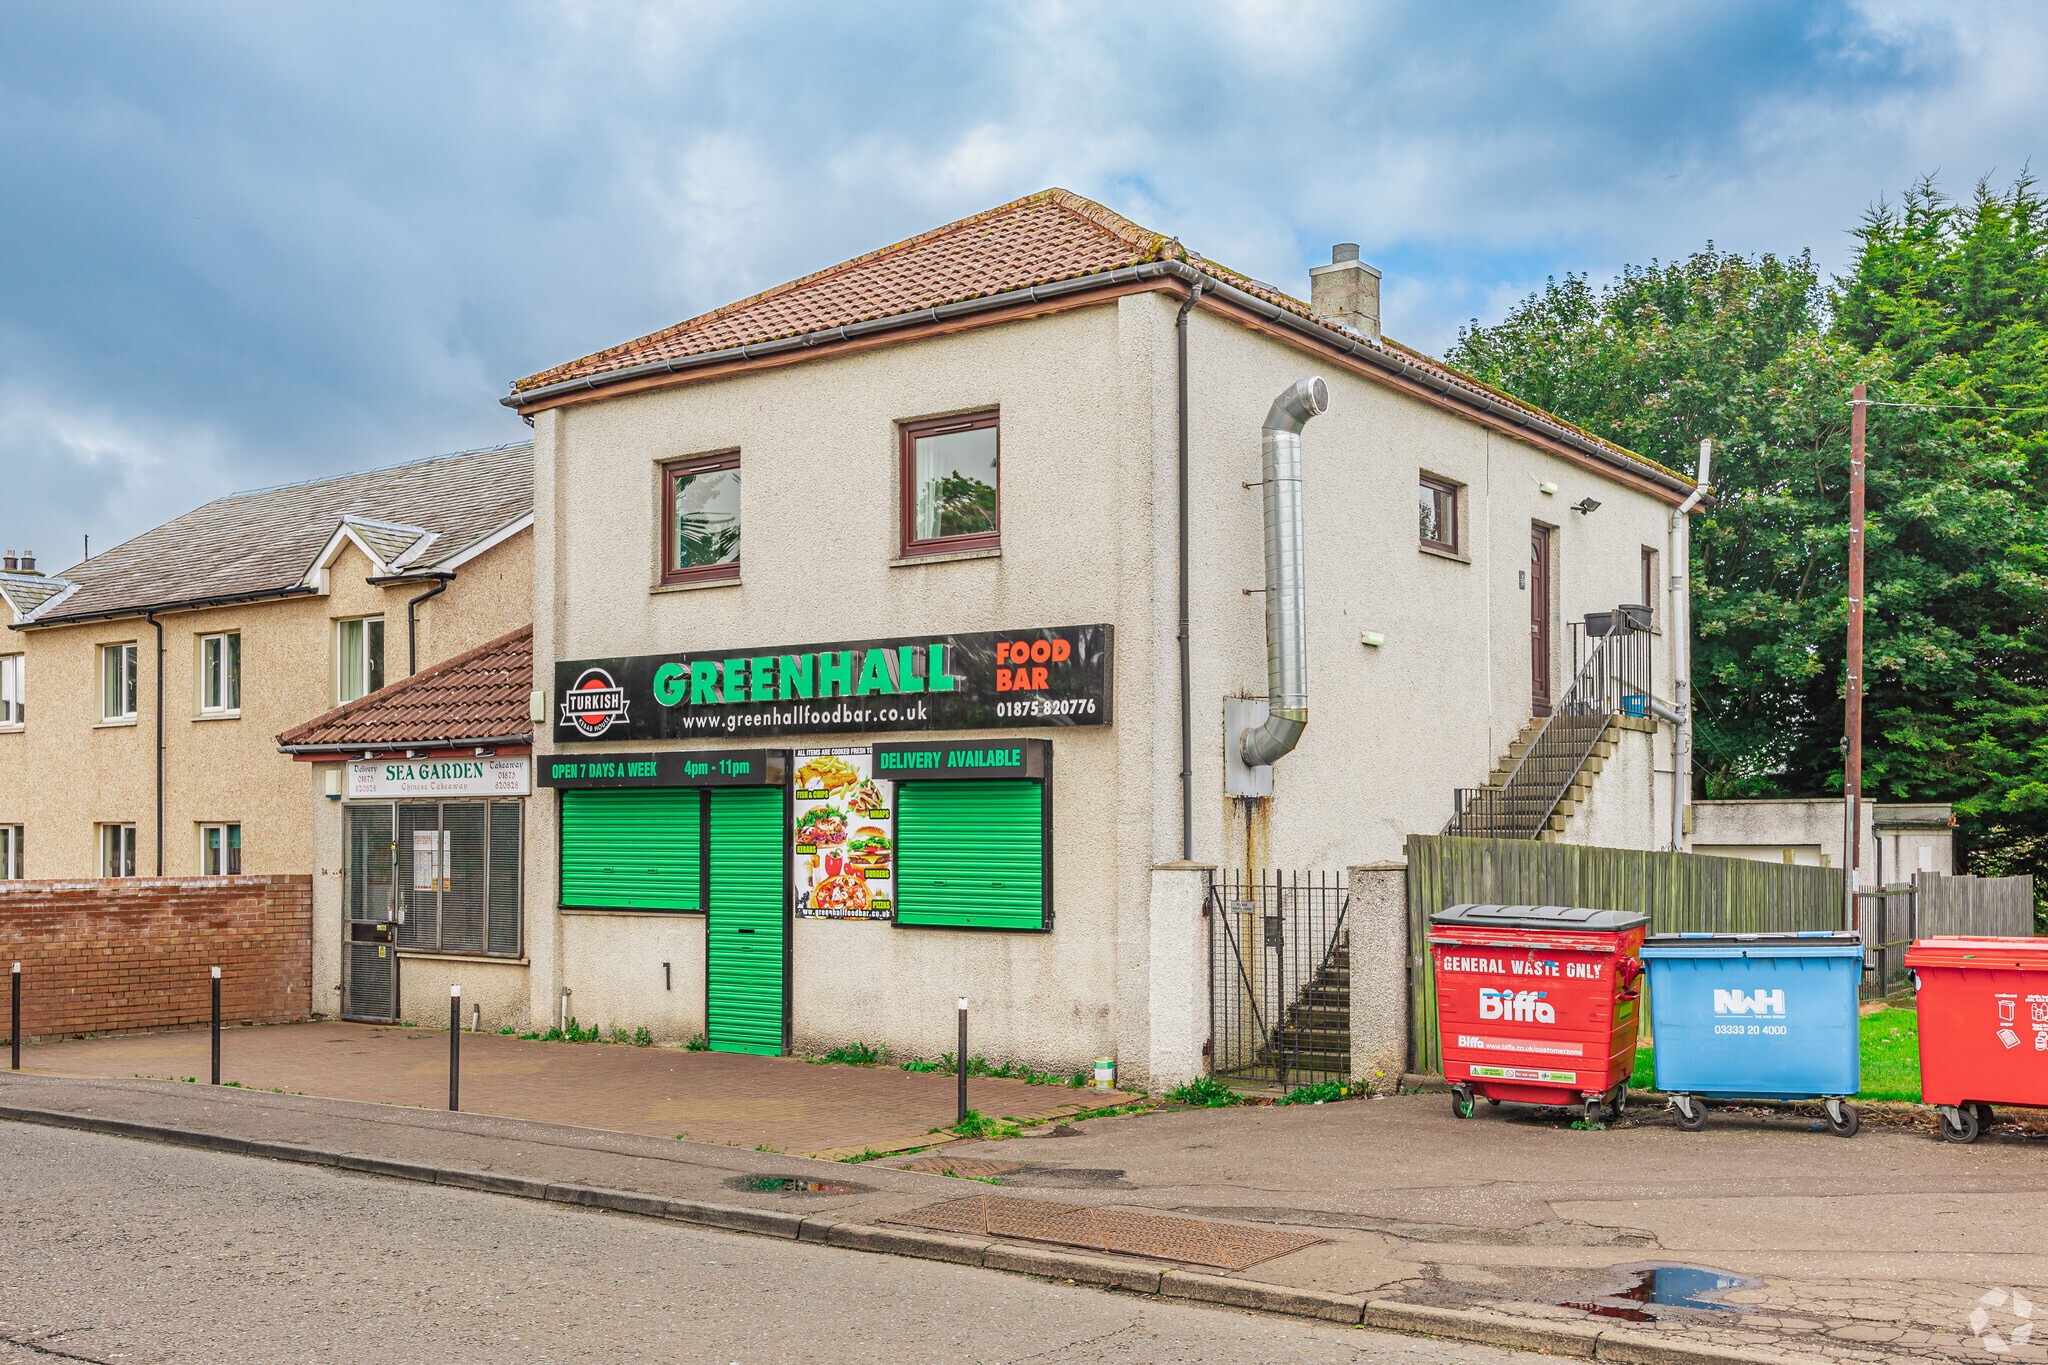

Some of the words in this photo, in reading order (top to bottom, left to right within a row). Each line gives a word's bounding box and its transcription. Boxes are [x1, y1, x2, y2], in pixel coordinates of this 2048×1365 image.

[996, 638, 1071, 665] FOOD
[653, 644, 955, 707] GREENHALL
[996, 667, 1049, 692] BAR
[570, 694, 619, 710] TURKISH
[996, 701, 1039, 717] 01875
[1043, 698, 1096, 716] 820776
[578, 717, 593, 732] KEBAB
[594, 716, 611, 732] HOUSE
[683, 700, 928, 732] www.greenhallfoodbar.co.uk
[489, 761, 523, 770] Takeaway
[880, 751, 941, 769] DELIVERY
[946, 748, 1021, 769] AVAILABLE
[354, 765, 378, 774] Delivery
[386, 764, 415, 781] SEA
[418, 762, 484, 780] GARDEN
[498, 771, 516, 779] 01875
[552, 763, 578, 779] OPEN
[580, 763, 587, 778] 7
[588, 762, 615, 778] DAYS
[617, 762, 625, 778] A
[627, 761, 657, 777] WEEK
[683, 760, 709, 779] 4pm
[719, 759, 750, 778] 11pm
[357, 775, 374, 783] 01875
[401, 782, 428, 791] Chinese
[430, 781, 468, 791] Takeaway
[494, 781, 519, 790] 820828
[796, 790, 808, 799] FISH
[813, 790, 829, 799] CHIPS
[869, 810, 890, 819] WRAPS
[865, 869, 890, 878] BURGERS
[872, 901, 891, 909] PIZZAS
[1443, 956, 1506, 974] GENERAL
[1511, 960, 1560, 977] WASTE
[1566, 962, 1602, 979] ONLY
[1479, 987, 1556, 1024] Biffa
[1714, 989, 1786, 1014] NWH
[1714, 1025, 1745, 1035] 03333
[1747, 1025, 1760, 1035] 20
[1762, 1025, 1787, 1035] 4000
[1458, 1035, 1485, 1048] Biffa
[1485, 1043, 1583, 1056] www.biffa.co.uk/customerzone
